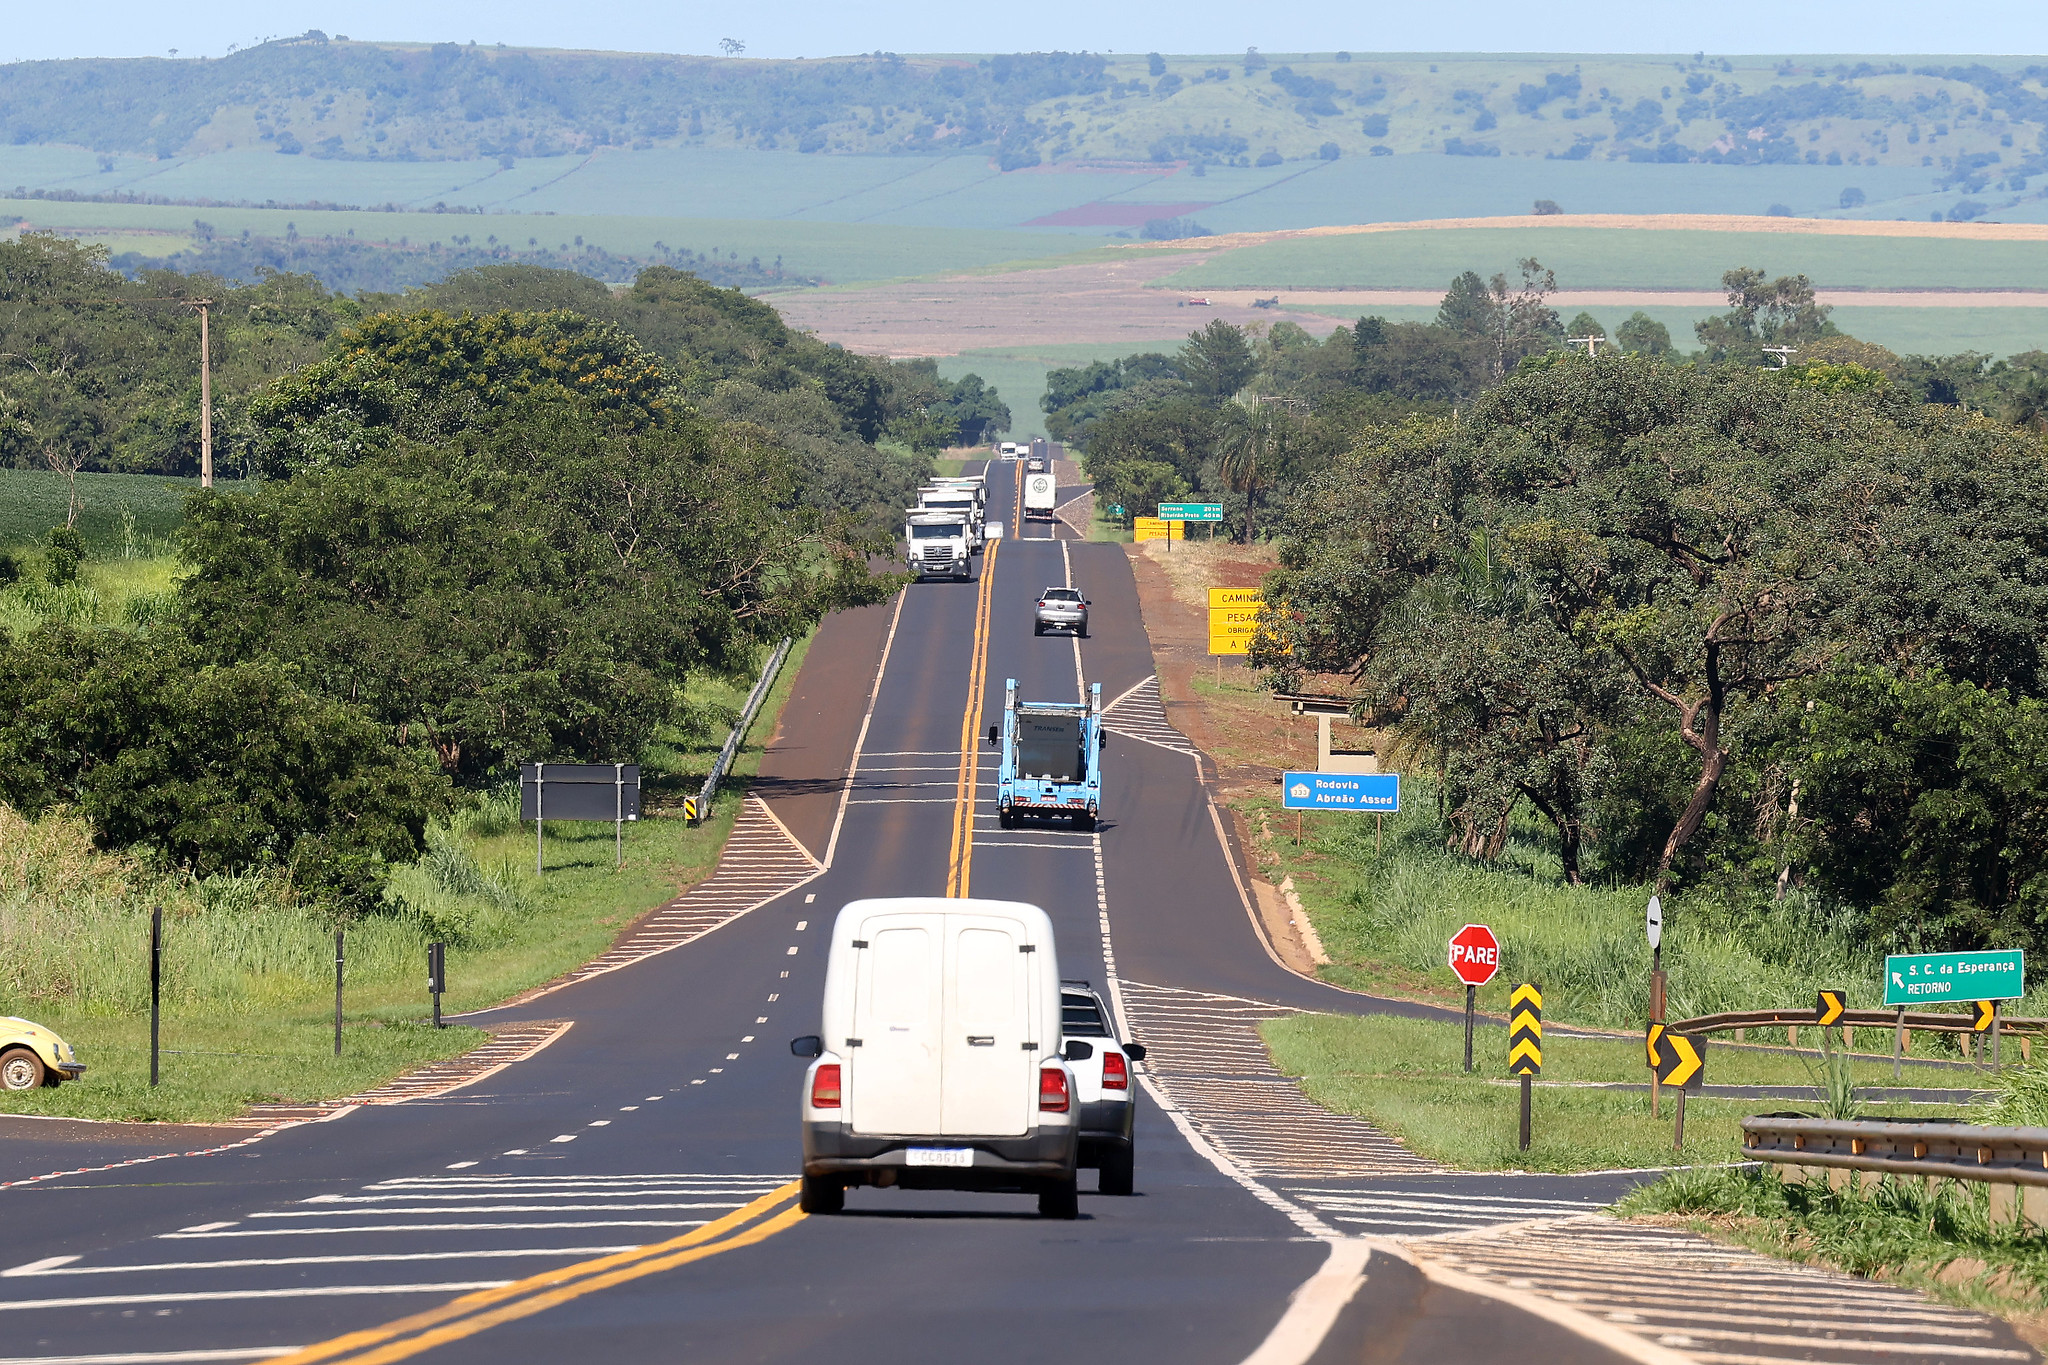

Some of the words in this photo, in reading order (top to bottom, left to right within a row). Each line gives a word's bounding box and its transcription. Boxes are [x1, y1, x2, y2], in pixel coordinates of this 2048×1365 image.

[1316, 780, 1359, 790] Rodovia
[1316, 794, 1355, 803] Abraão
[1360, 794, 1392, 804] Assed
[1454, 944, 1496, 965] PARE
[1909, 965, 1919, 976] S.
[1924, 964, 1934, 975] C.
[1940, 964, 1952, 974] da
[1958, 961, 2015, 976] Esperança
[1907, 982, 1952, 995] RETORNO
